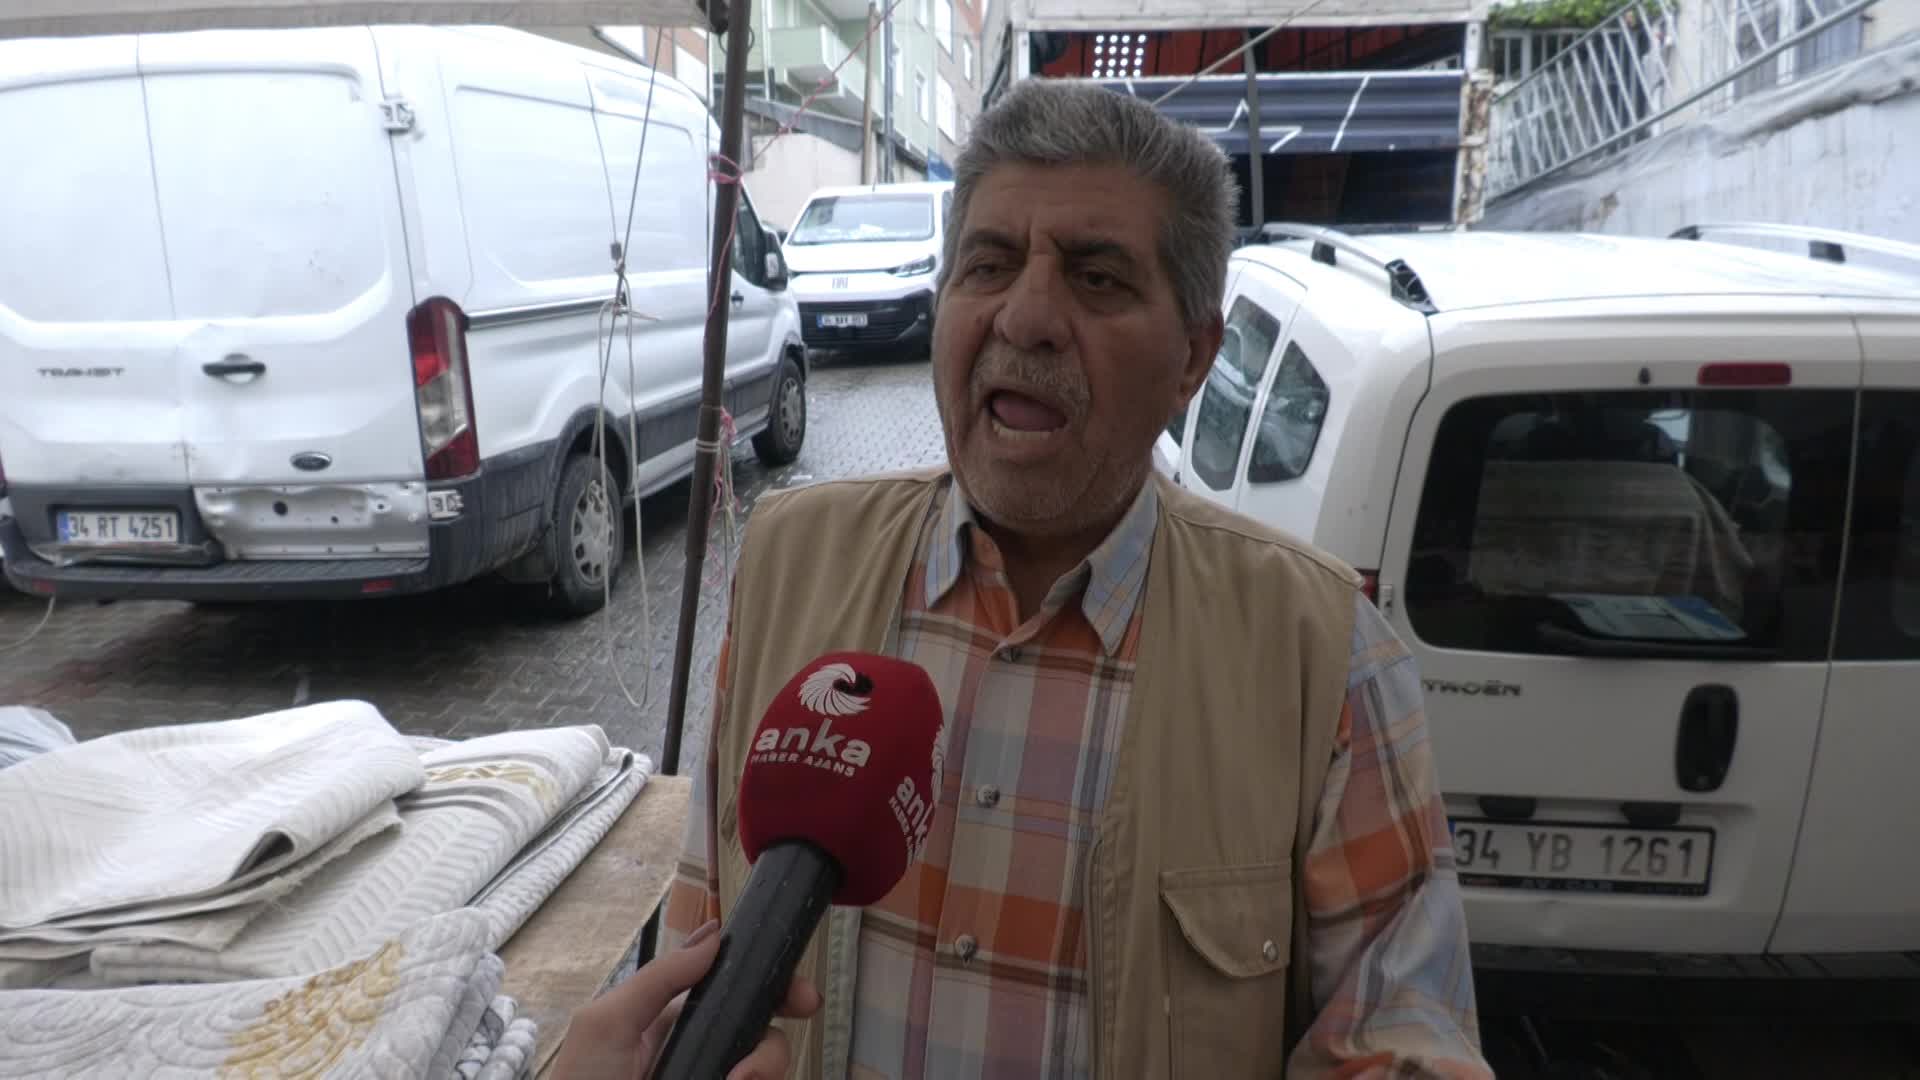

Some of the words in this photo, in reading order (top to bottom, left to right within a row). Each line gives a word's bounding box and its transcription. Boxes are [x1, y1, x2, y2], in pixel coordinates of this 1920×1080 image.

[69, 516, 89, 537] 34
[97, 516, 120, 537] RT
[128, 516, 173, 537] 4251
[751, 752, 799, 765] HABER
[755, 718, 872, 768] anka
[1455, 828, 1500, 870] 34
[1526, 832, 1573, 873] YB
[1600, 836, 1694, 878] 1261
